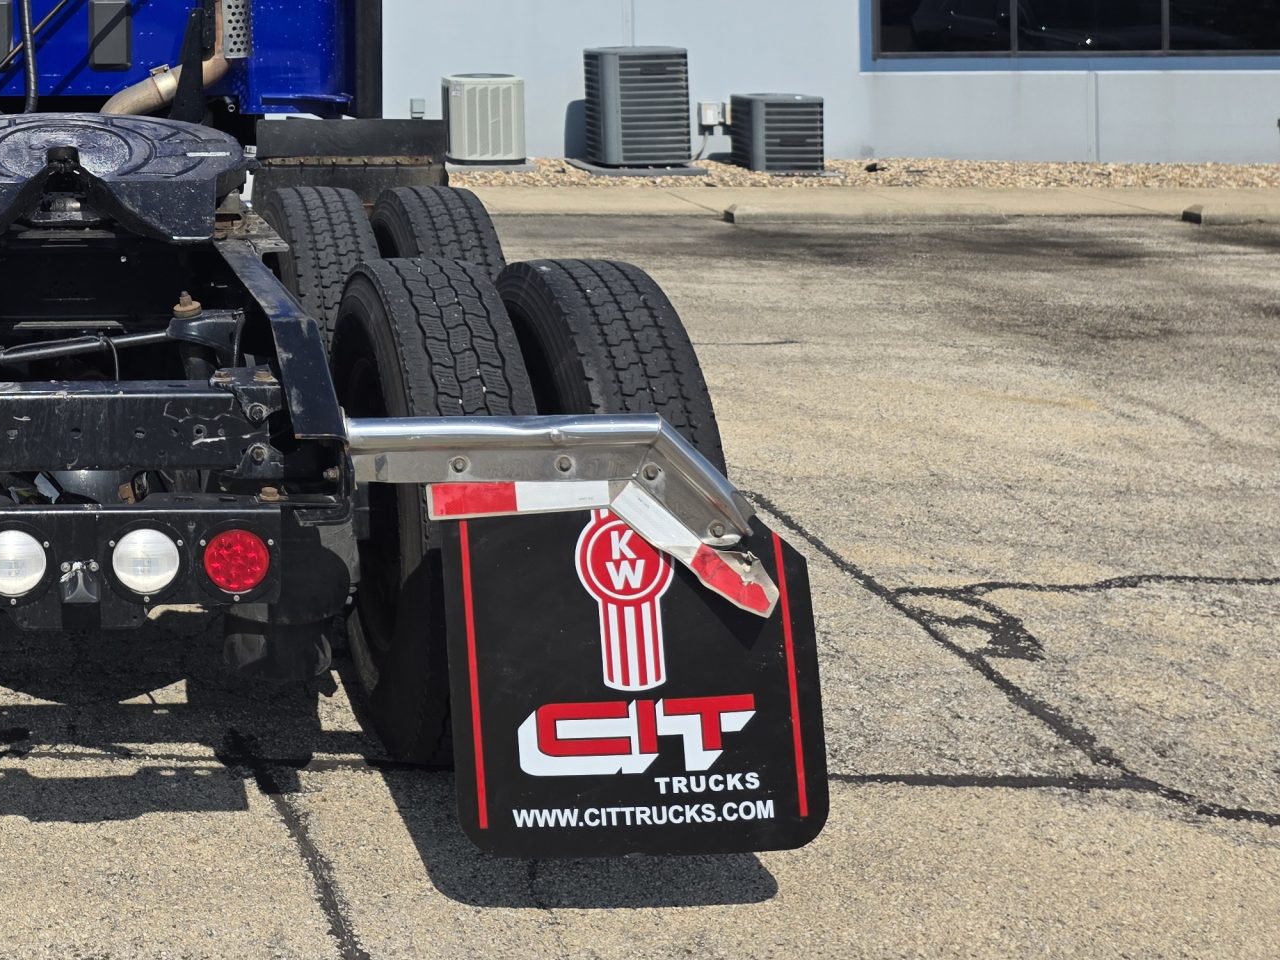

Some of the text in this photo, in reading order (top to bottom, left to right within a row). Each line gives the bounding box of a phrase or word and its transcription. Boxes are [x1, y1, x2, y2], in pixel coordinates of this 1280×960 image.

[517, 694, 756, 776] CIT
[654, 771, 760, 794] TRUCKS
[512, 800, 775, 828] WWW.CITTRUCKS.COM
